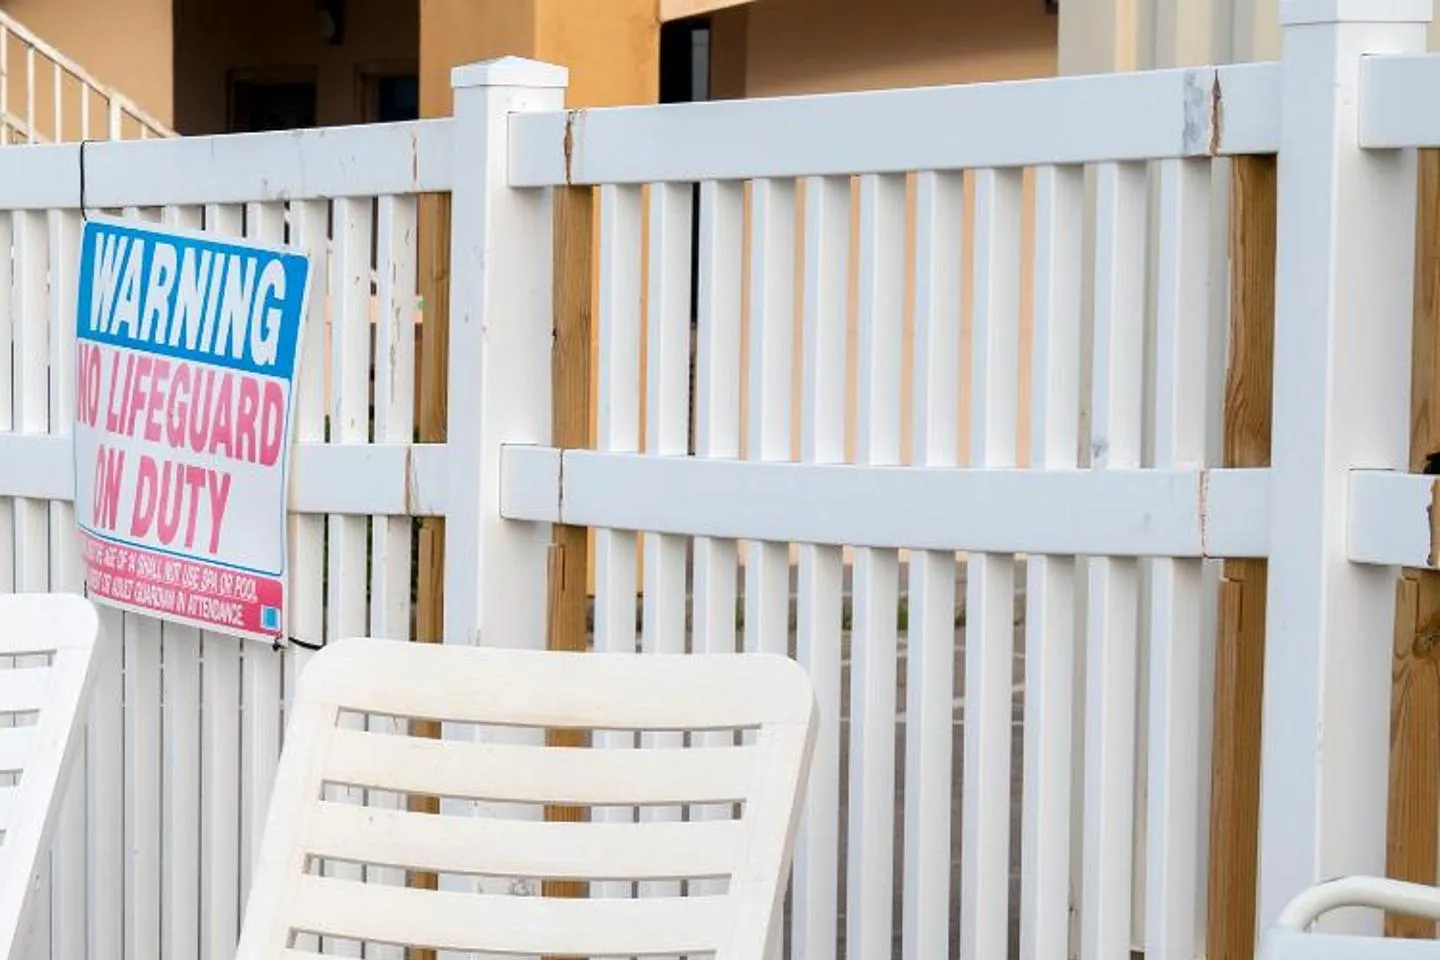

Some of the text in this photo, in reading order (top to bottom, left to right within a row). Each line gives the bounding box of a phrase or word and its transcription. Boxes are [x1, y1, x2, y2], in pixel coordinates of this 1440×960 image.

[90, 232, 287, 366] WARNING
[77, 343, 284, 467] NO LIFEGUARD
[93, 444, 231, 554] ON DUTY
[163, 560, 181, 586] NOT
[182, 563, 200, 590] USE
[200, 567, 218, 593] SPA
[234, 575, 258, 603] POOL
[177, 590, 187, 613] IN
[188, 593, 245, 625] ATTENDANCE
